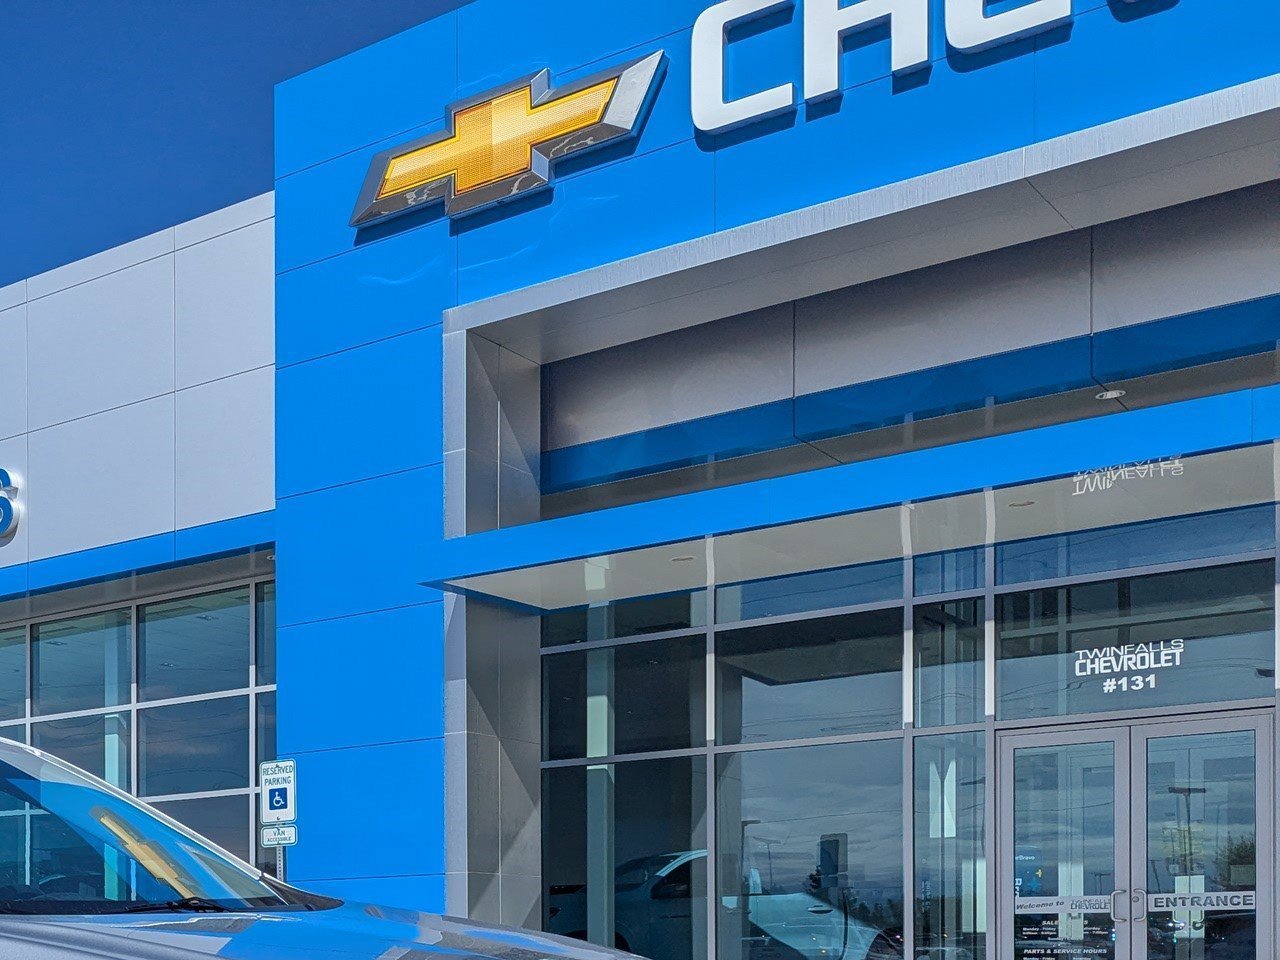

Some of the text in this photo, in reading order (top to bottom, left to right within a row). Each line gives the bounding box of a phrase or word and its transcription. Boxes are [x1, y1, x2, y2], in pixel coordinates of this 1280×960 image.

[1075, 639, 1184, 660] TWINFALLS
[1075, 649, 1184, 676] CHEVROLET
[1103, 674, 1156, 693] #131
[263, 765, 293, 776] RESERVED
[264, 776, 292, 786] PARKING
[1016, 902, 1054, 911] Welcome
[1154, 895, 1254, 909] ENTRANCE
